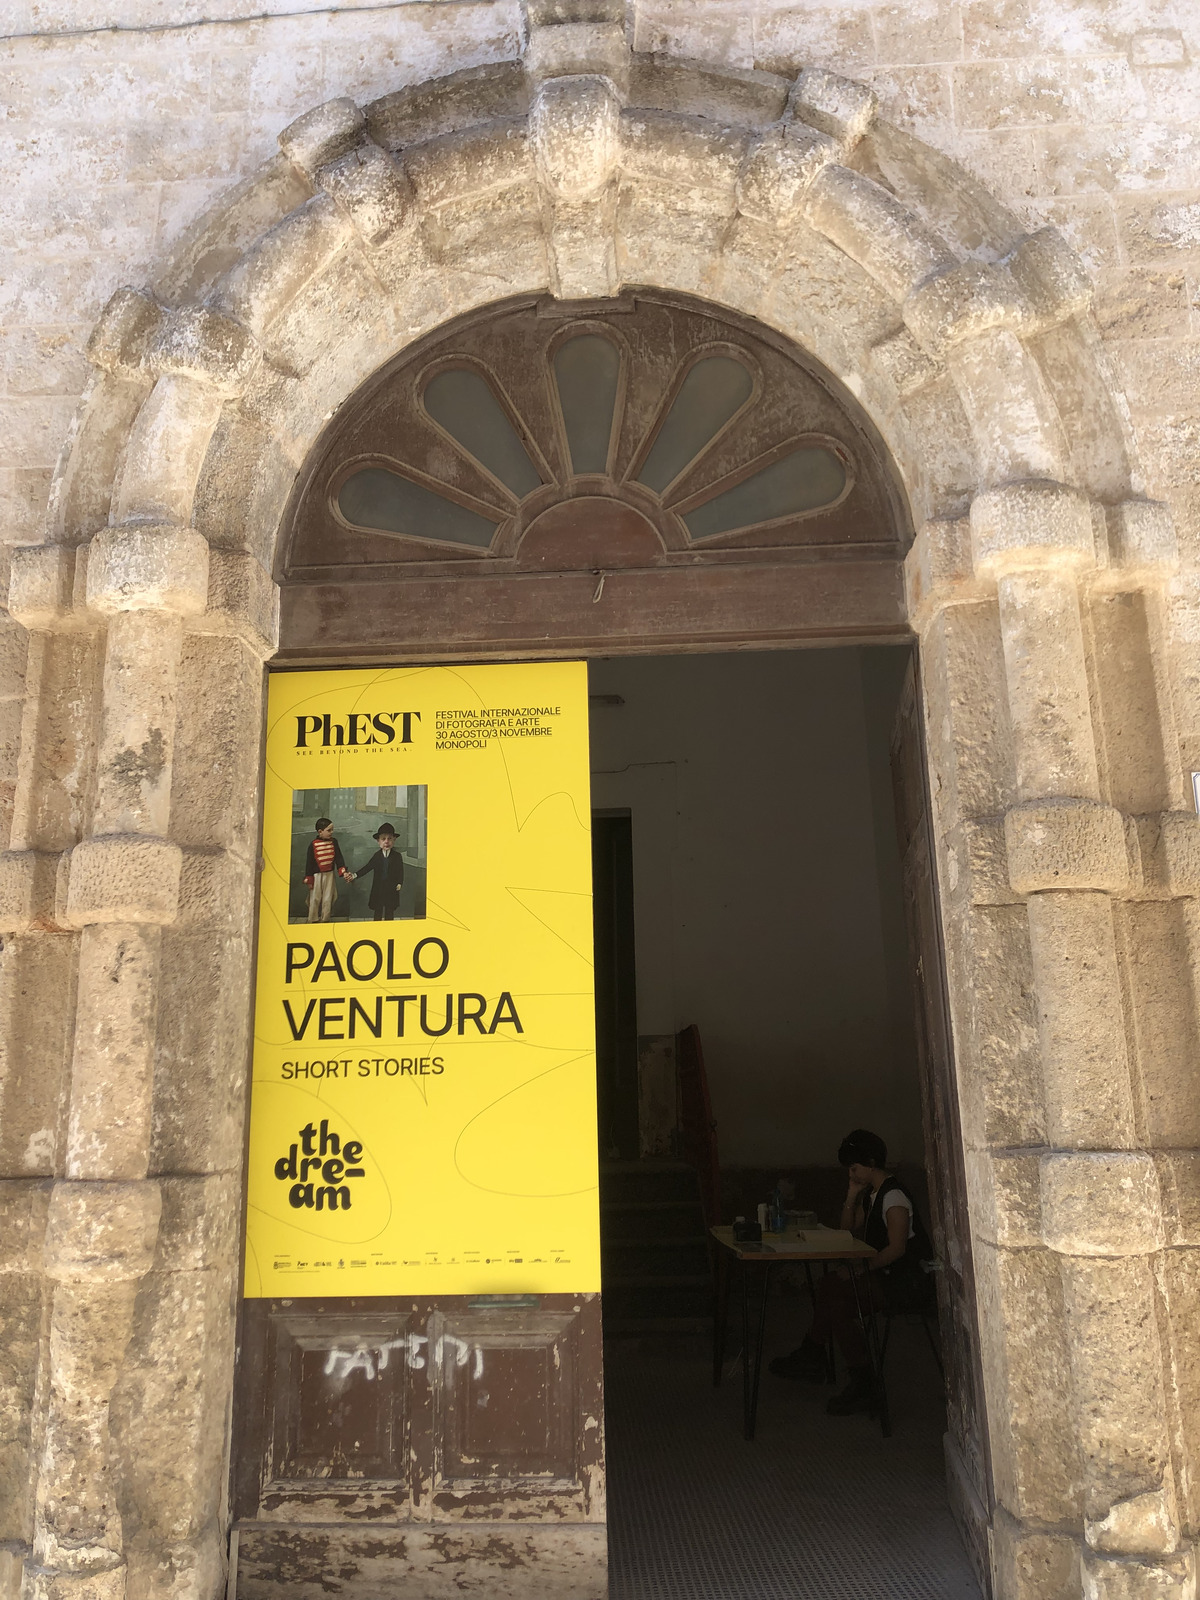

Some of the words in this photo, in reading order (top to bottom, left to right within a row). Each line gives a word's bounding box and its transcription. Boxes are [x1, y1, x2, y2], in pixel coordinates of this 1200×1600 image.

[435, 710, 478, 719] FESTIVAL
[480, 706, 561, 718] INTERNAZIONALE
[435, 721, 445, 729] DI
[446, 718, 507, 729] FOTOGRAFIA
[508, 718, 514, 726] E
[515, 717, 540, 727] ARTE
[293, 711, 421, 748] PhEST
[435, 731, 448, 740] 30
[449, 728, 498, 739] AGOSTO/3
[499, 727, 553, 737] NOVEMBRE
[435, 739, 487, 749] MONOPOLI
[285, 936, 450, 984] PAOLO
[281, 991, 525, 1041] VENTURA
[281, 1058, 353, 1080] SHORT
[357, 1056, 445, 1078] STORIES
[299, 1119, 364, 1165] the
[288, 1181, 352, 1212] am
